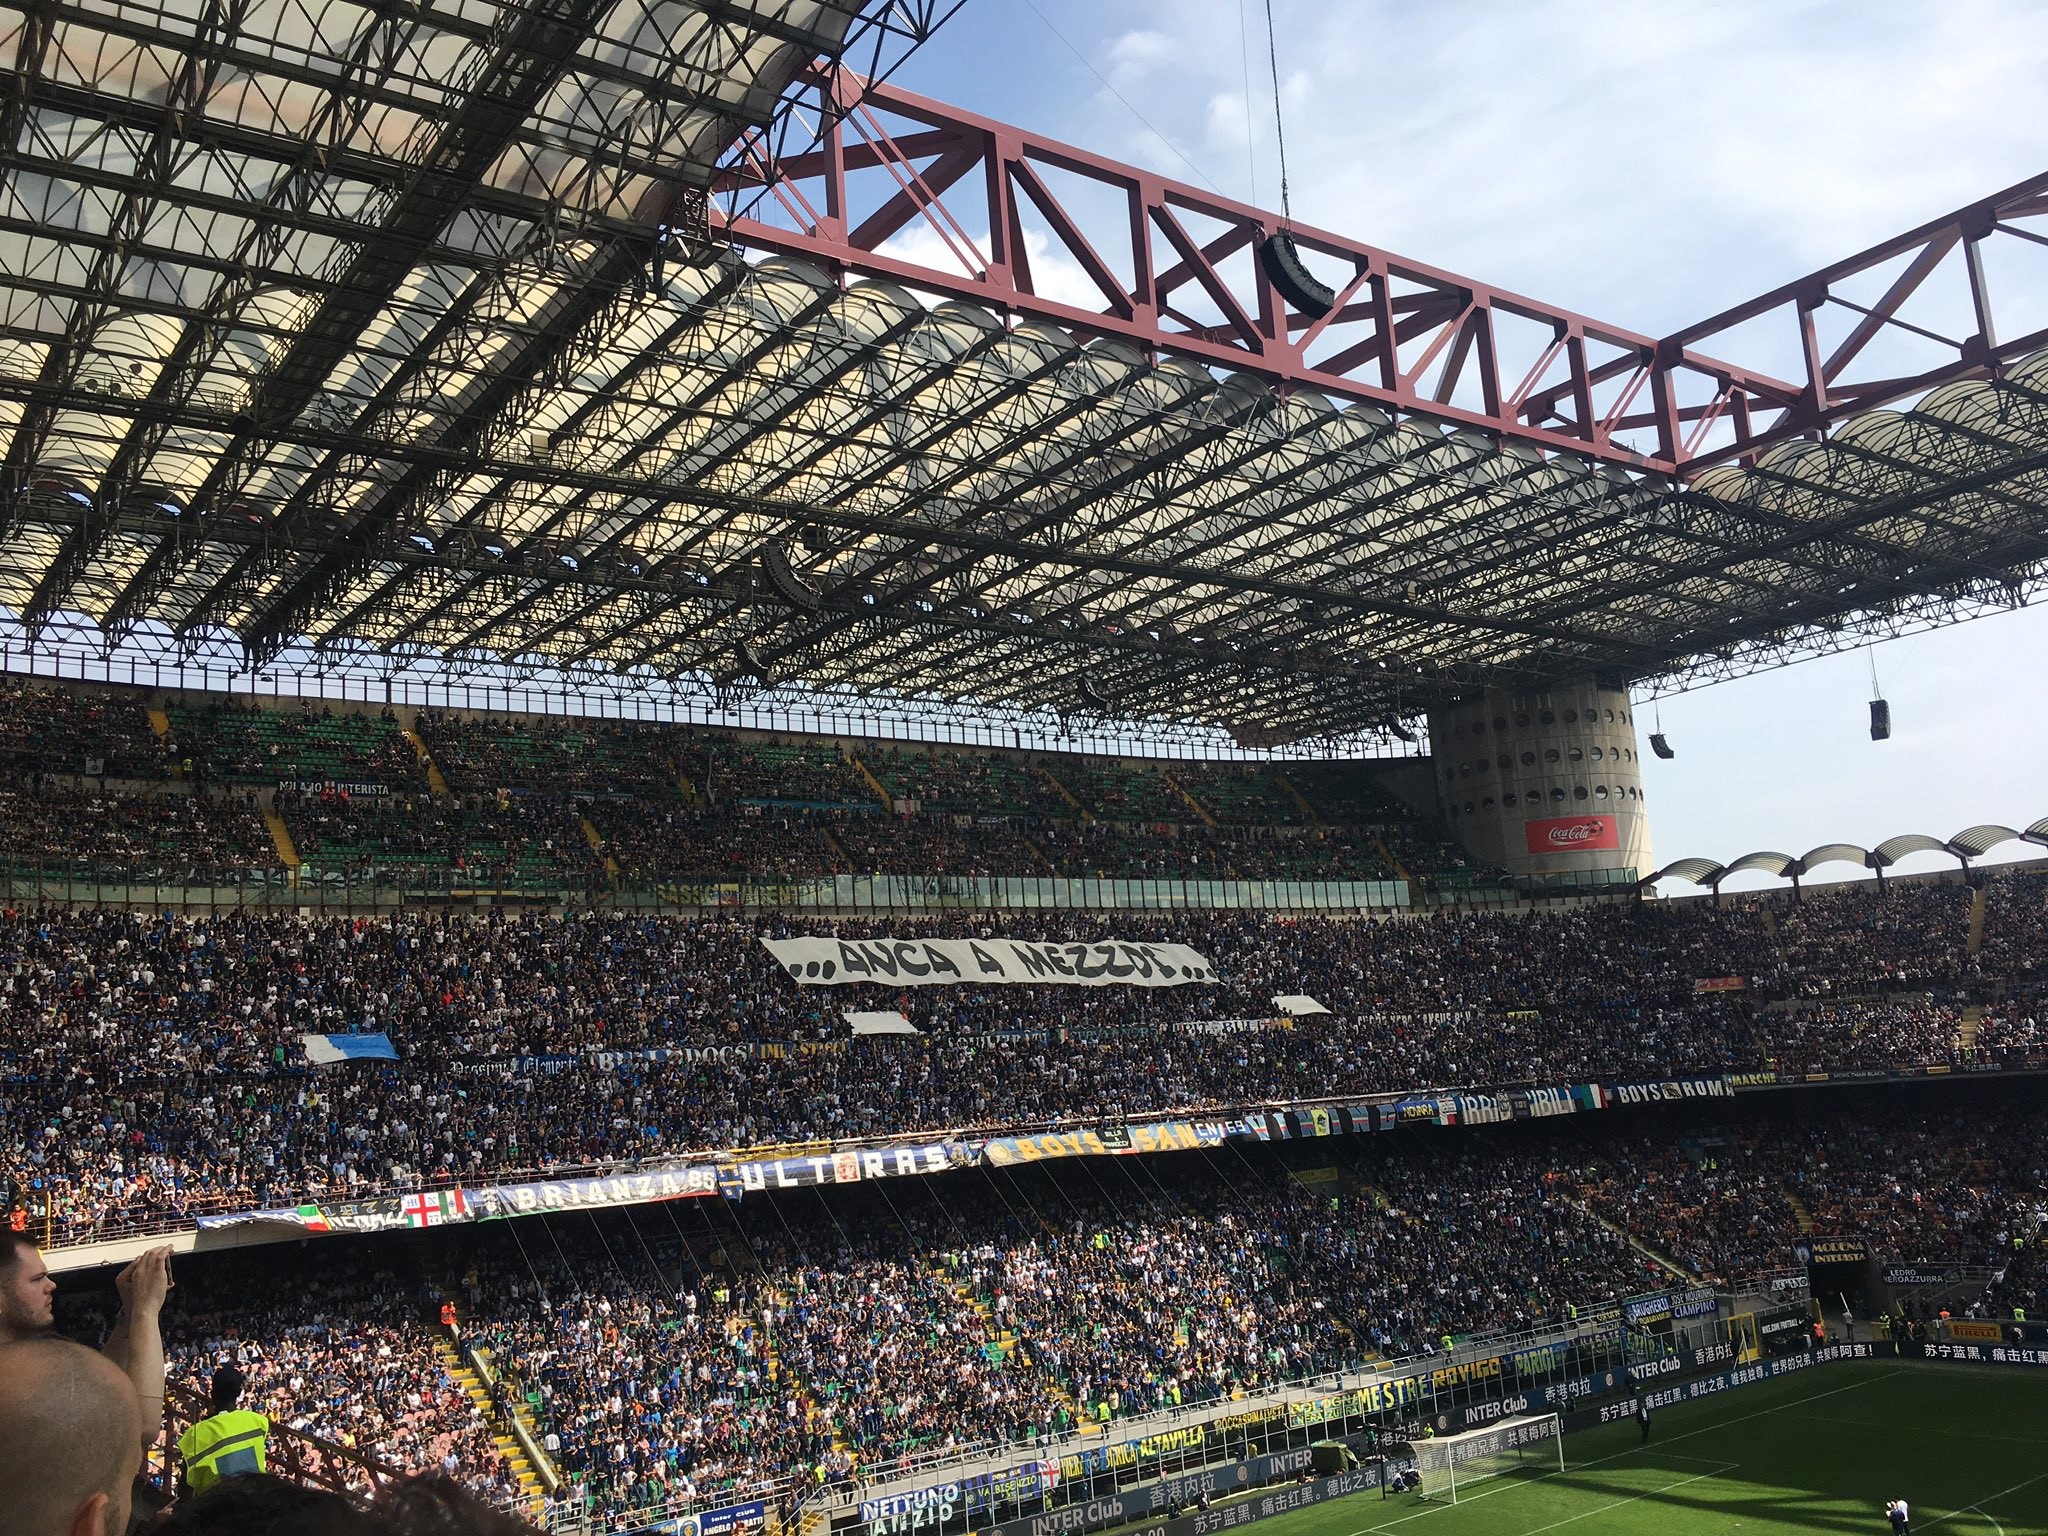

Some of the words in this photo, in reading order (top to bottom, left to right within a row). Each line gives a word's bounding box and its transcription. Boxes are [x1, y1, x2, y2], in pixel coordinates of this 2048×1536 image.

[337, 783, 389, 796] INTERISTA
[1549, 825, 1591, 840] Coca-Cola
[968, 941, 1005, 975] A
[1617, 1083, 1661, 1105] BOYS
[1682, 1080, 1735, 1098] ROMA
[1733, 1073, 1776, 1087] MARCHE
[1015, 1132, 1105, 1161] BOYS
[1135, 1123, 1200, 1151] SAN
[1194, 1122, 1217, 1139] CN
[1228, 1120, 1245, 1133] 69
[740, 1146, 946, 1191] ULTRAS
[516, 1174, 681, 1210] BRIANZA
[687, 1169, 714, 1189] 85
[1812, 1241, 1865, 1253] MODENA
[1815, 1253, 1866, 1264] INTERISTA
[1685, 1287, 1714, 1302] MOURINHO
[1674, 1300, 1716, 1318] CIAMPINO
[1954, 1325, 1997, 1338] PIRELLI
[1515, 1347, 1556, 1377] PARIGI
[1660, 1355, 1681, 1373] Club
[1695, 1341, 1733, 1366] 香港内拉
[1433, 1357, 1501, 1389] ROVIGO
[1357, 1373, 1430, 1414] MESTRE
[1545, 1377, 1592, 1403] 香港内拉
[1290, 1394, 1358, 1417] BOLOGNA
[1465, 1401, 1501, 1425] INTER
[1502, 1394, 1528, 1414] Club
[1140, 1425, 1205, 1458] ALTAVILLA
[1105, 1445, 1137, 1469] BERICA
[1270, 1449, 1313, 1475] INTER
[862, 1484, 959, 1521] NETTUNO
[1150, 1471, 1216, 1509] 香港内拉
[735, 1508, 756, 1518] CLUB
[873, 1504, 953, 1536] ANZIO
[1031, 1503, 1084, 1536] INTER
[1087, 1497, 1124, 1522] Club
[703, 1522, 731, 1536] ANGELO
